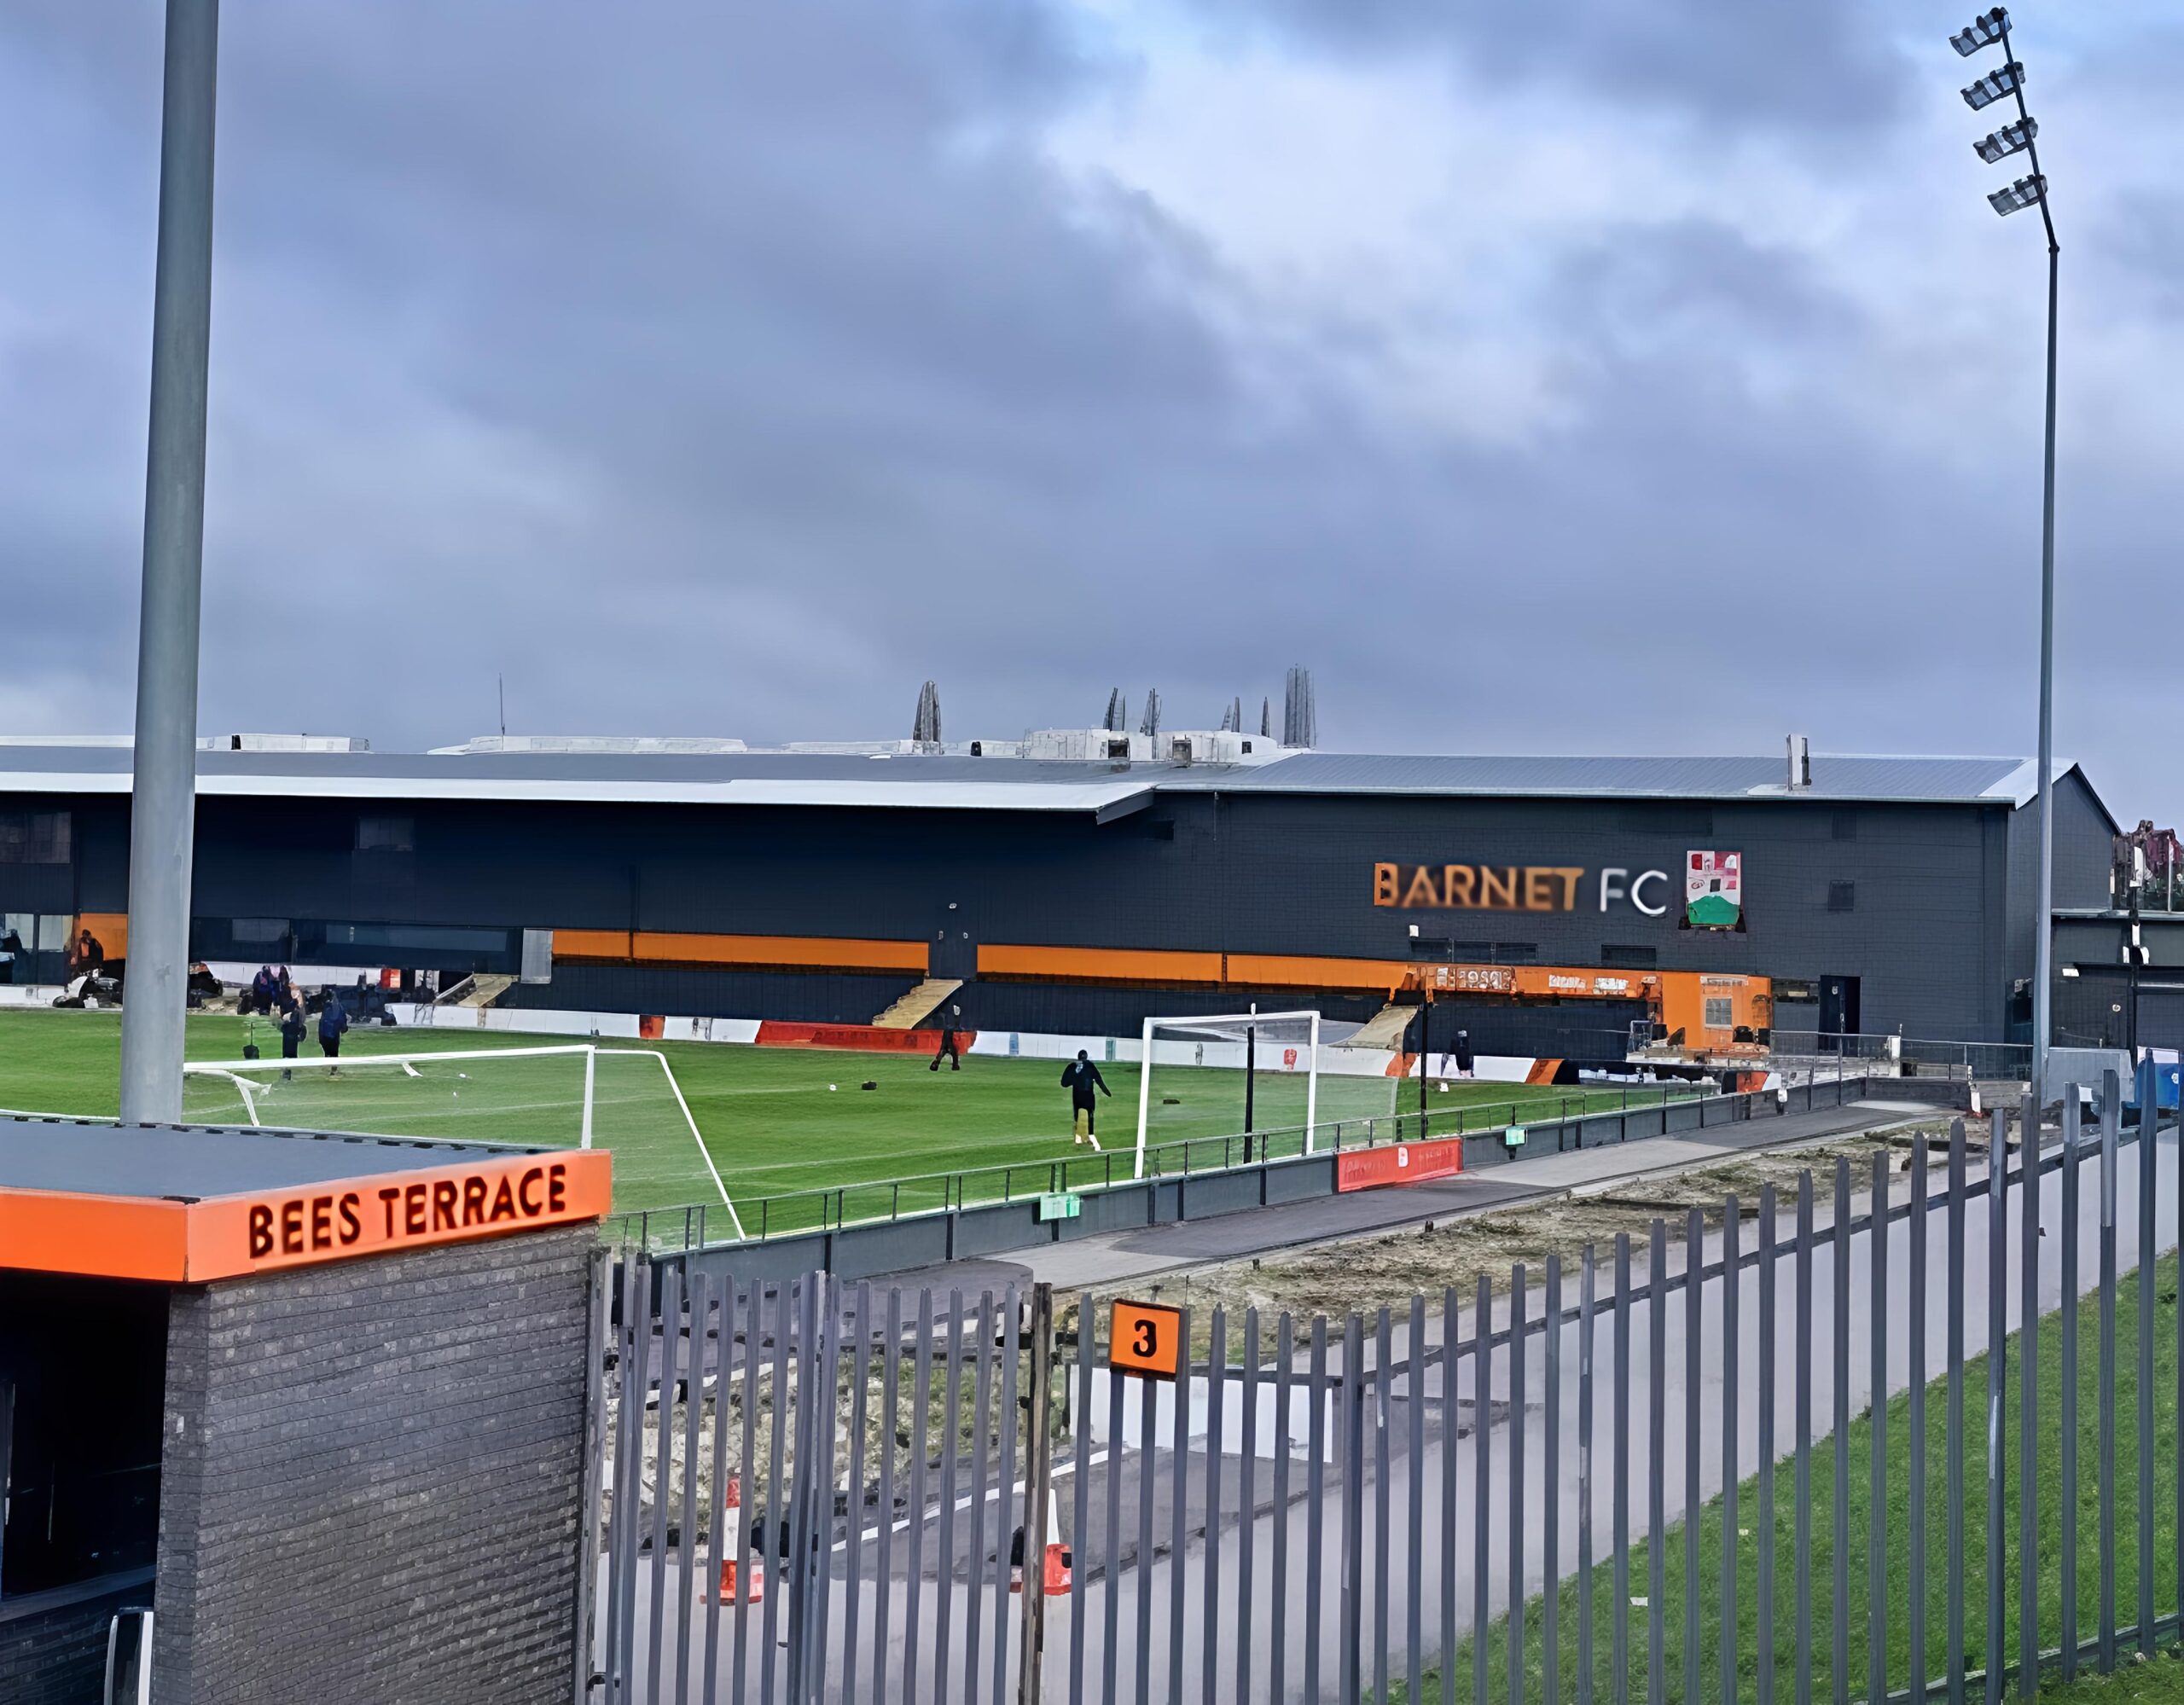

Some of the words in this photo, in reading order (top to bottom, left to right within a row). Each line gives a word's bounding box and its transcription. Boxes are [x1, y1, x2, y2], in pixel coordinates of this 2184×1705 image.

[1374, 862, 1584, 911] BARNET
[1600, 867, 1668, 916] FC
[250, 1193, 360, 1259] BEES
[378, 1164, 566, 1239] TERRACE
[1132, 1319, 1158, 1358] 3
